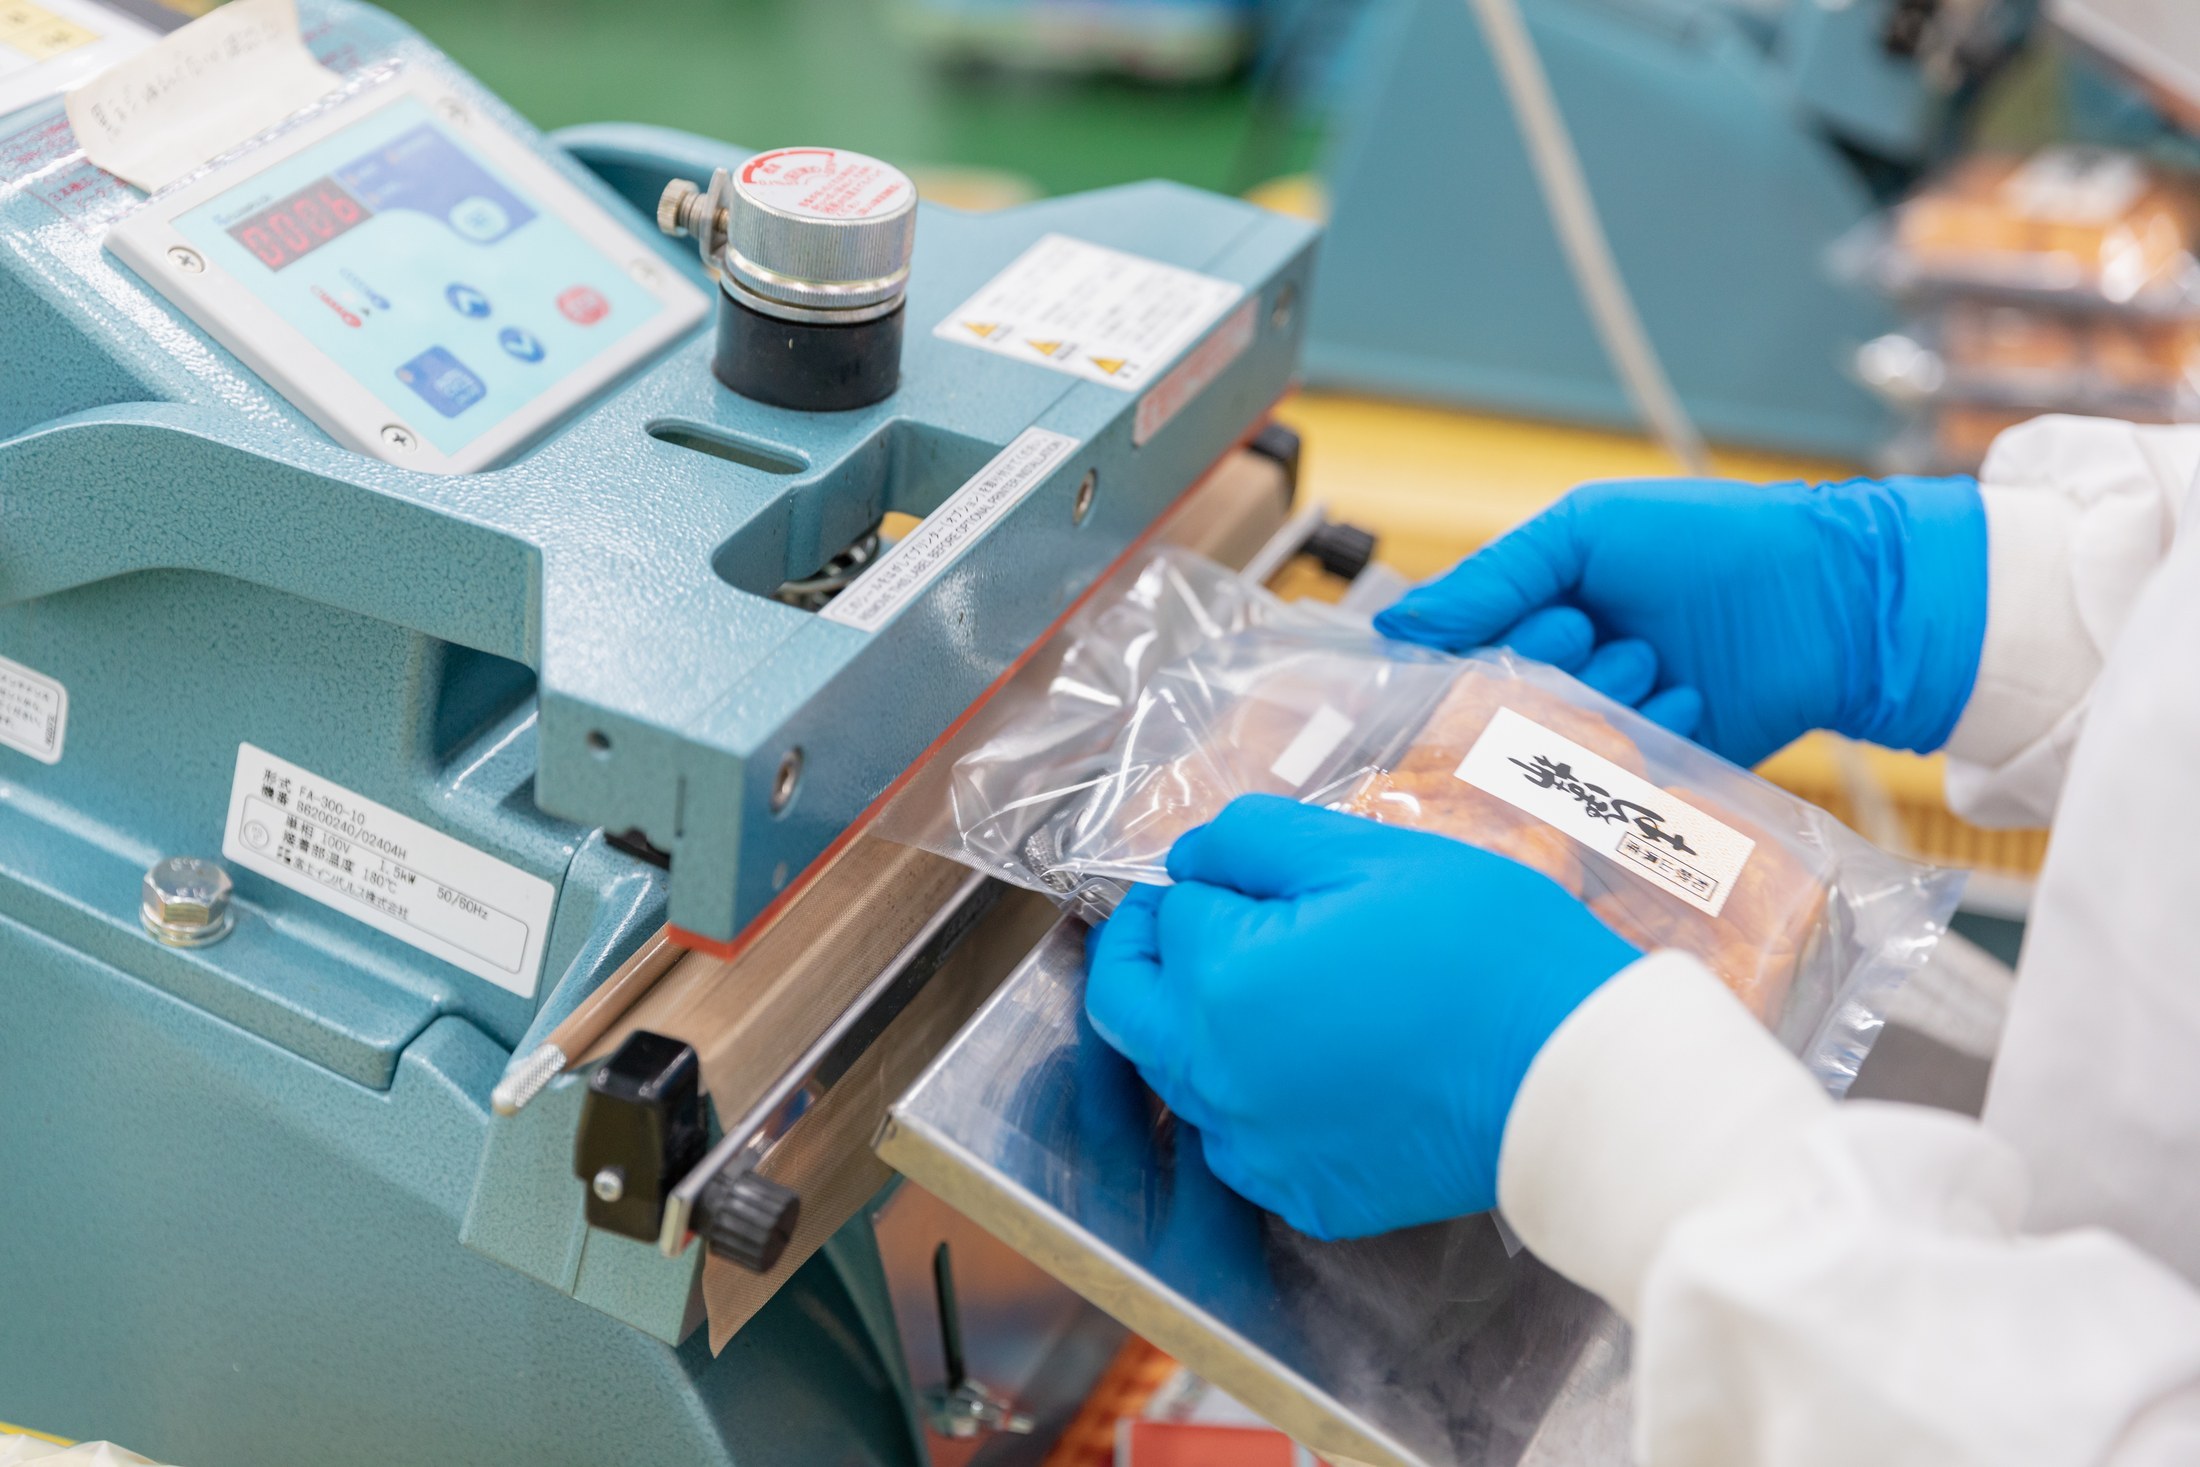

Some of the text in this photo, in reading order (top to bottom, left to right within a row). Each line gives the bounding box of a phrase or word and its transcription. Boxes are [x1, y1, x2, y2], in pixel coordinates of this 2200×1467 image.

[904, 557, 934, 579] LABEL
[926, 532, 962, 559] BEFORE
[953, 502, 995, 534] OPTIONAL
[986, 477, 1022, 504] PRINTER
[299, 786, 365, 825] FA-300-10
[322, 832, 350, 854] 100V
[380, 860, 416, 884] 1.5kW
[436, 887, 489, 920] 50/60Hz
